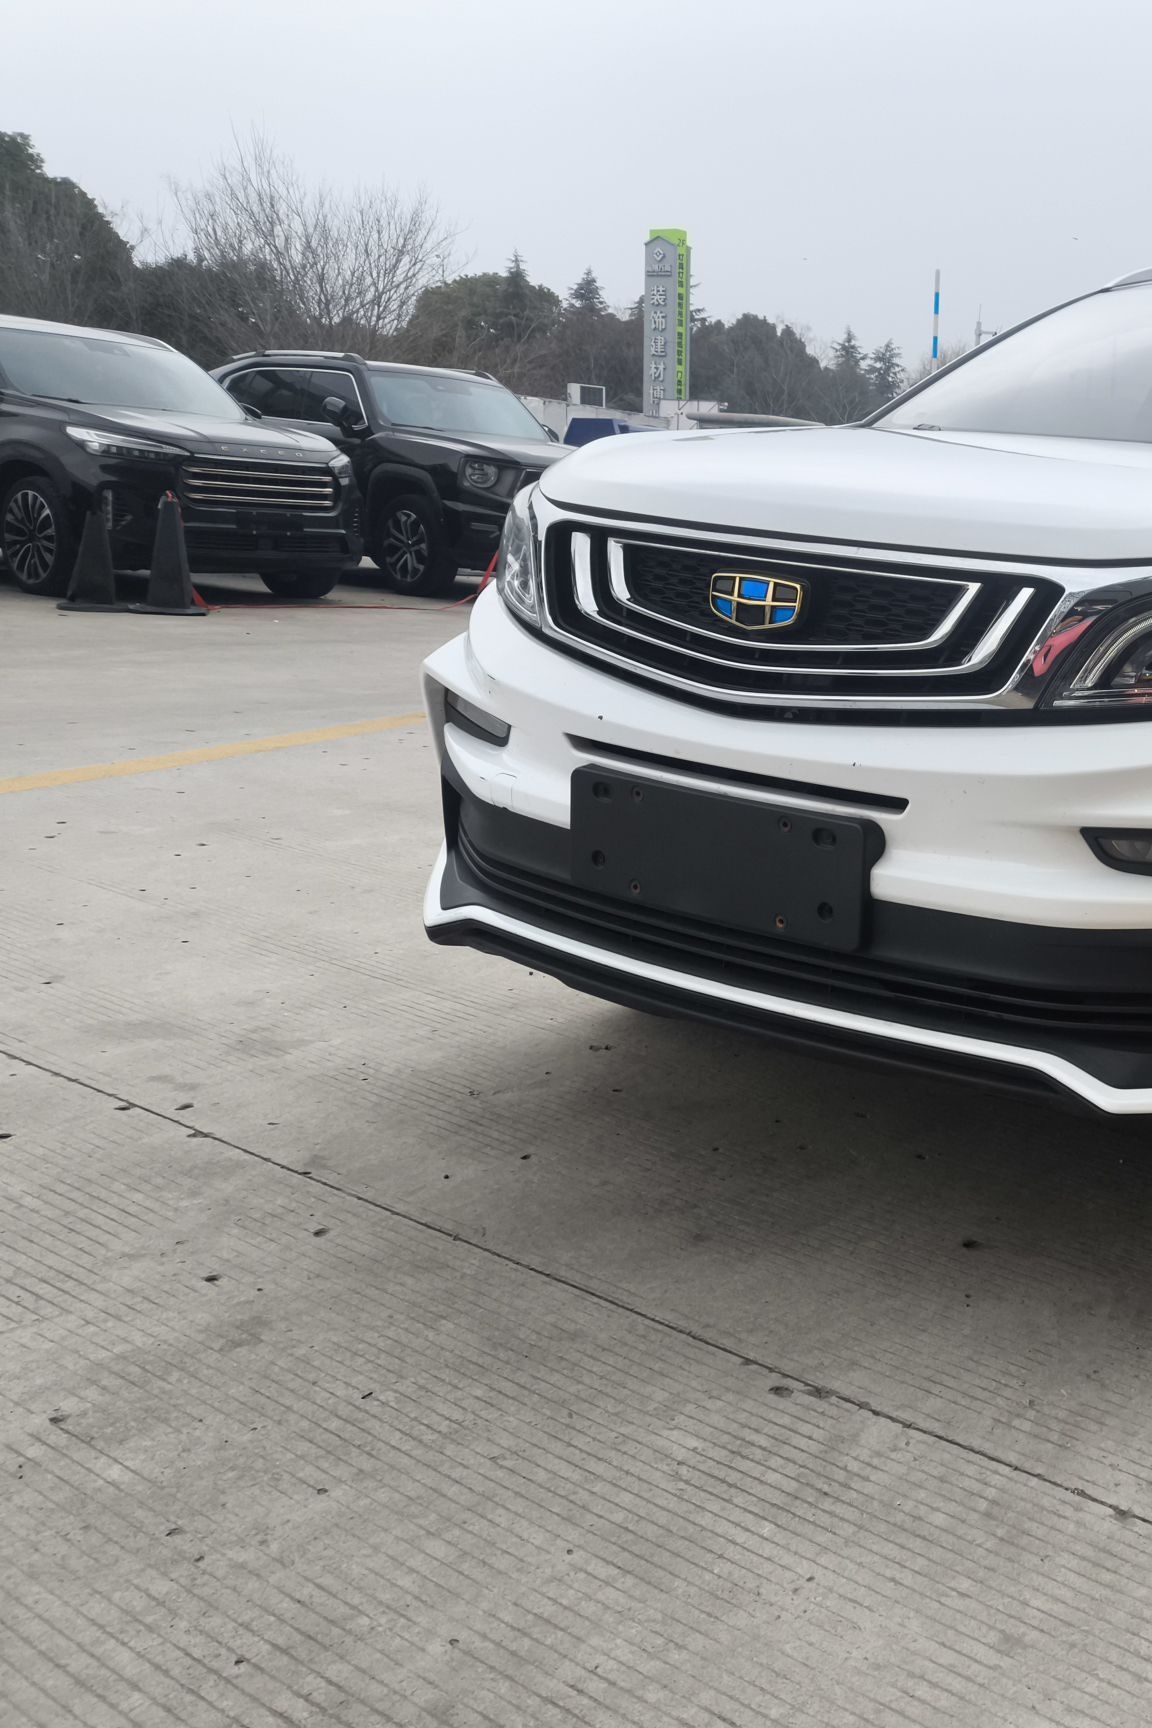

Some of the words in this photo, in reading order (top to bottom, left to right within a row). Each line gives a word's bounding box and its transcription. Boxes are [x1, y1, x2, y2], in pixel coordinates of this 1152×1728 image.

[649, 286, 667, 416] 装饰建材博
